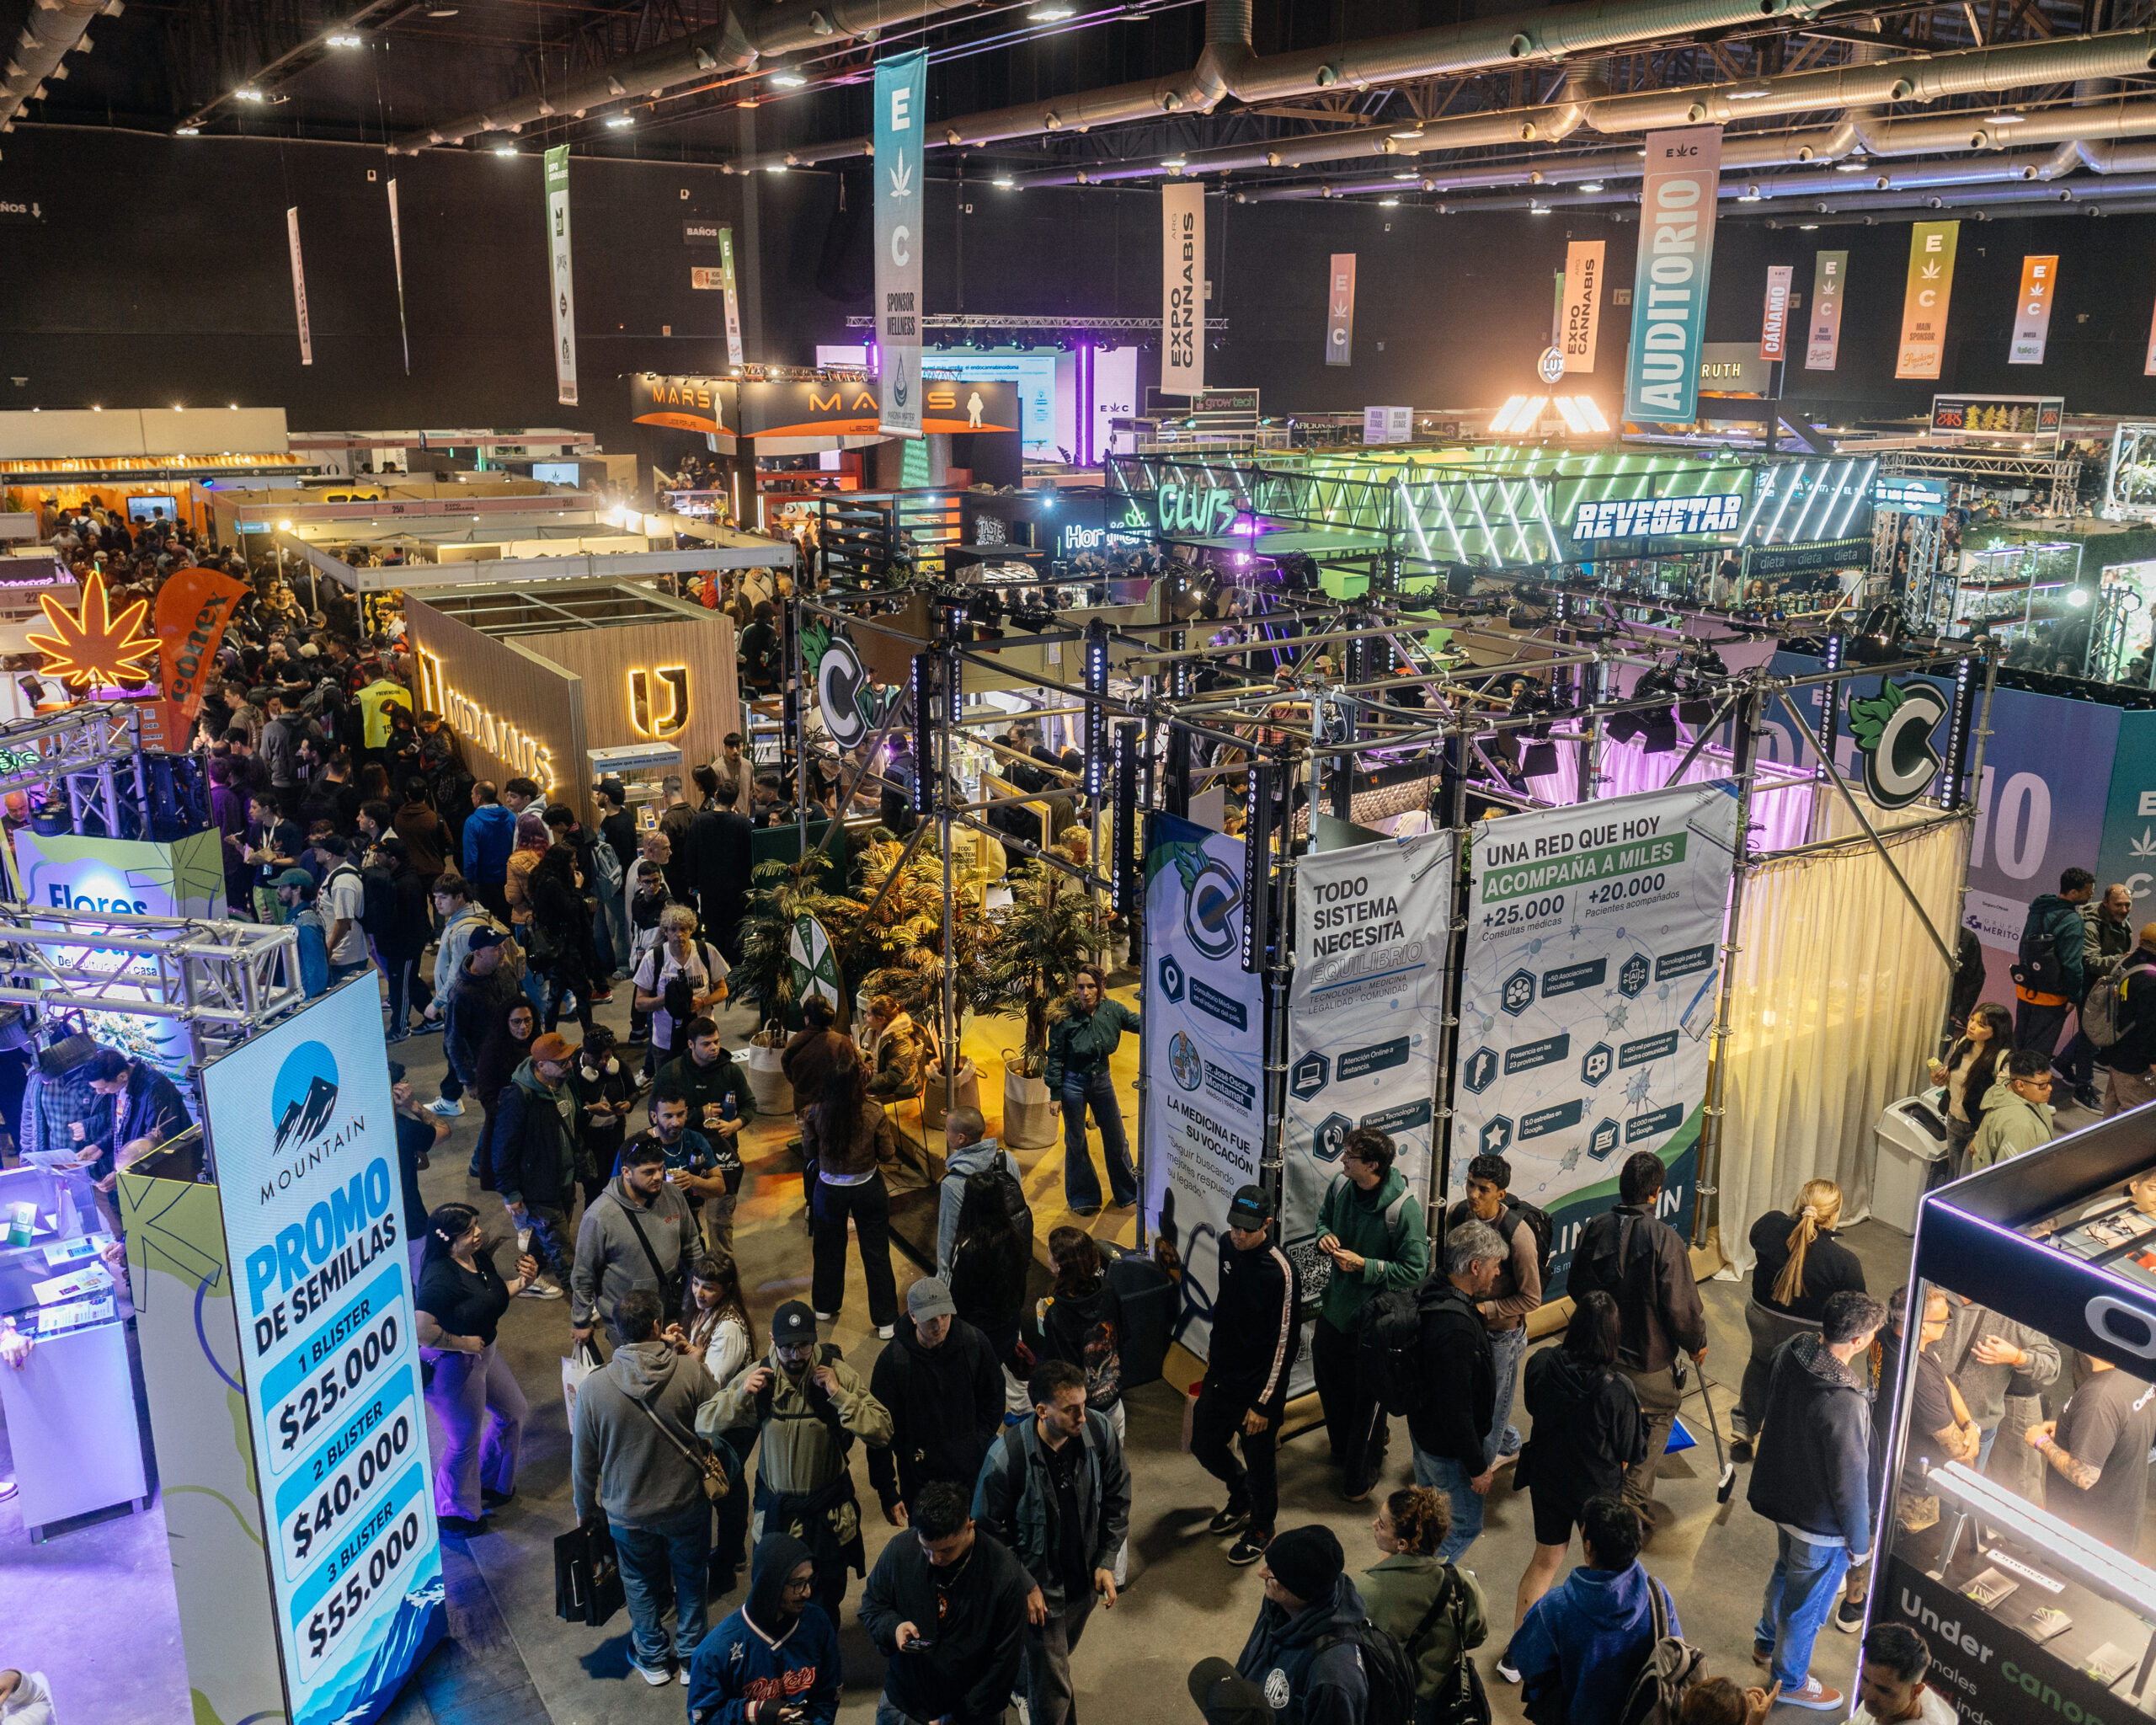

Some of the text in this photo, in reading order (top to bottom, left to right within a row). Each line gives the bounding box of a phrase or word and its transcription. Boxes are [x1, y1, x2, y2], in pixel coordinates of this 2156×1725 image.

[1666, 146, 1698, 158] E C
[892, 88, 910, 266] E C
[687, 227, 717, 237] BAÑOS
[1919, 234, 1943, 307] E C
[887, 292, 914, 312] SPONSOR
[1182, 211, 1194, 368] CANNABIS
[1641, 179, 1701, 410] AUDITORIO
[1821, 261, 1837, 316] E C
[2027, 265, 2047, 315] E C
[1333, 275, 1348, 345] E C
[1577, 258, 1595, 355] CANNABIS
[887, 316, 915, 336] WELLNESS
[1171, 287, 1181, 367] EXPO
[1568, 305, 1580, 355] EXPO
[1909, 333, 1935, 341] SPONSOR
[1916, 323, 1931, 331] MAIN
[653, 386, 711, 409] MARS
[809, 392, 957, 412] MAS
[1371, 410, 1383, 419] MAIN
[1574, 496, 1742, 540] REVEGETAR
[1760, 556, 1785, 569] dieta
[1798, 553, 1822, 565] dieta
[1834, 549, 1858, 562] dieta
[171, 591, 230, 702] conex
[1486, 815, 1660, 867] UNA RED QUE HOY
[1485, 841, 1674, 899] ACOMPAÑA A MILES
[1313, 877, 1369, 905] TODO
[1585, 889, 1680, 918] Pacientes acompañados
[1588, 873, 1666, 905] +20.000
[1313, 896, 1398, 931] SISTEMA
[1483, 895, 1565, 927] +25.000
[1984, 918, 2020, 932] GRUPO
[1313, 921, 1405, 958] NECESITA
[1482, 916, 1562, 942] Consultas médicas
[1983, 926, 2020, 941] MERITO
[133, 965, 157, 976] casa
[1310, 942, 1422, 985] EQUILIBRIO
[1308, 984, 1408, 1015] LEGALIDAD COMUNIDAD
[1309, 974, 1407, 1004] TECNOLOGÍA MEDICINA
[1342, 1053, 1370, 1065] Atención
[1370, 1049, 1390, 1060] Online
[1342, 1062, 1371, 1075] distancia.
[1205, 1074, 1245, 1105] Montamat
[1214, 1067, 1229, 1081] José
[1230, 1077, 1248, 1092] Oscar
[1166, 1095, 1251, 1156] LA MEDICINA FUE
[1365, 1116, 1384, 1126] Nueva
[261, 1115, 365, 1206] MOUNTAIN
[1186, 1125, 1253, 1176] SU VOCACIÓN
[1166, 1151, 1236, 1202] mejores respuest
[1167, 1172, 1177, 1183] su
[1195, 1151, 1235, 1186] buscando
[245, 1157, 390, 1317] PROMO
[254, 1213, 396, 1358] DE SEMILLAS
[297, 1299, 371, 1375] 1 BLISTER
[280, 1315, 398, 1451] $25.000
[313, 1400, 384, 1482] 2 BLISTER
[295, 1414, 409, 1559] $40.000
[328, 1501, 393, 1583] 3 BLISTER
[309, 1511, 419, 1659] $55.000
[1901, 1588, 1994, 1664] Under
